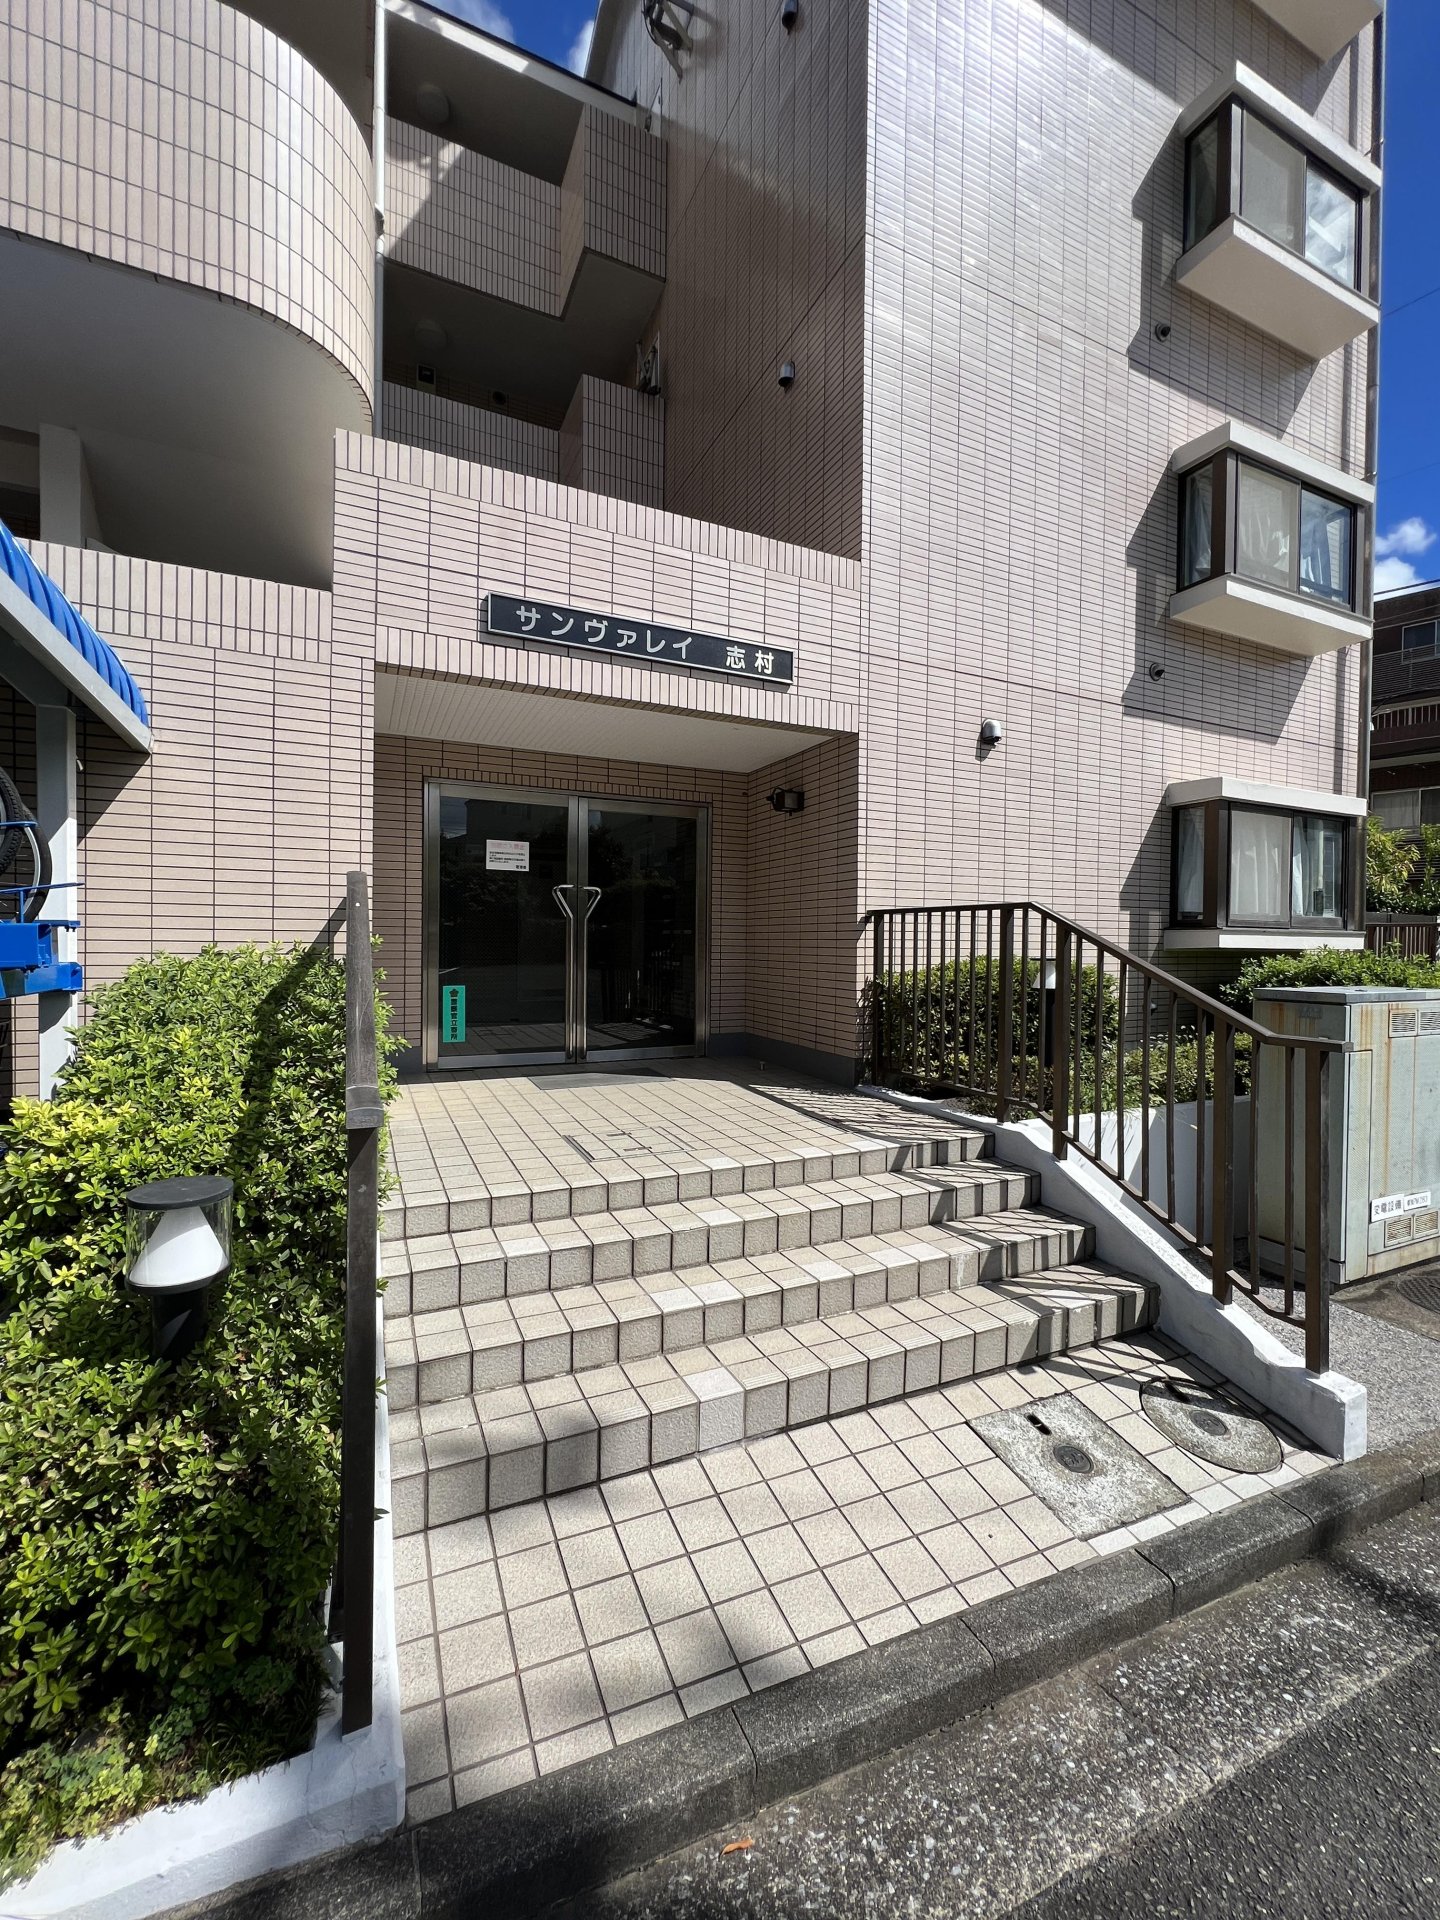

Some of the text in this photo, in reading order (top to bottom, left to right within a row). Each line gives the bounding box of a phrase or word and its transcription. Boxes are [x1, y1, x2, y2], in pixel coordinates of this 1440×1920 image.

[515, 605, 774, 676] サンヴァレイ 志村
